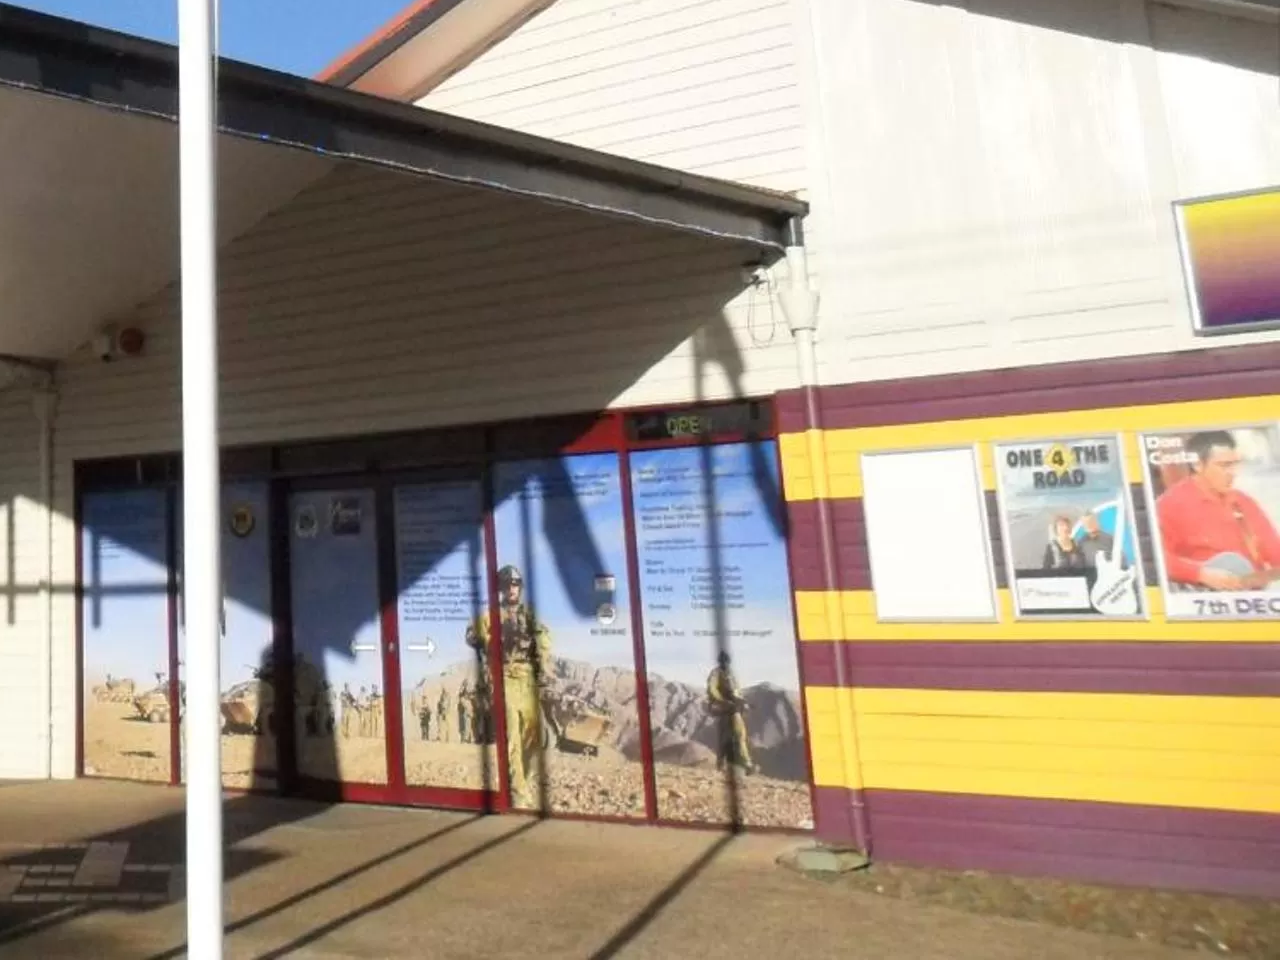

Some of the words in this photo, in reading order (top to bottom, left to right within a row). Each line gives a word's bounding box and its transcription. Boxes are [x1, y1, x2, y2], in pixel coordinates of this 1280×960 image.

[1006, 449, 1043, 468] ONE
[1051, 449, 1065, 467] 4
[1072, 444, 1109, 464] THE
[1032, 469, 1085, 489] ROAD
